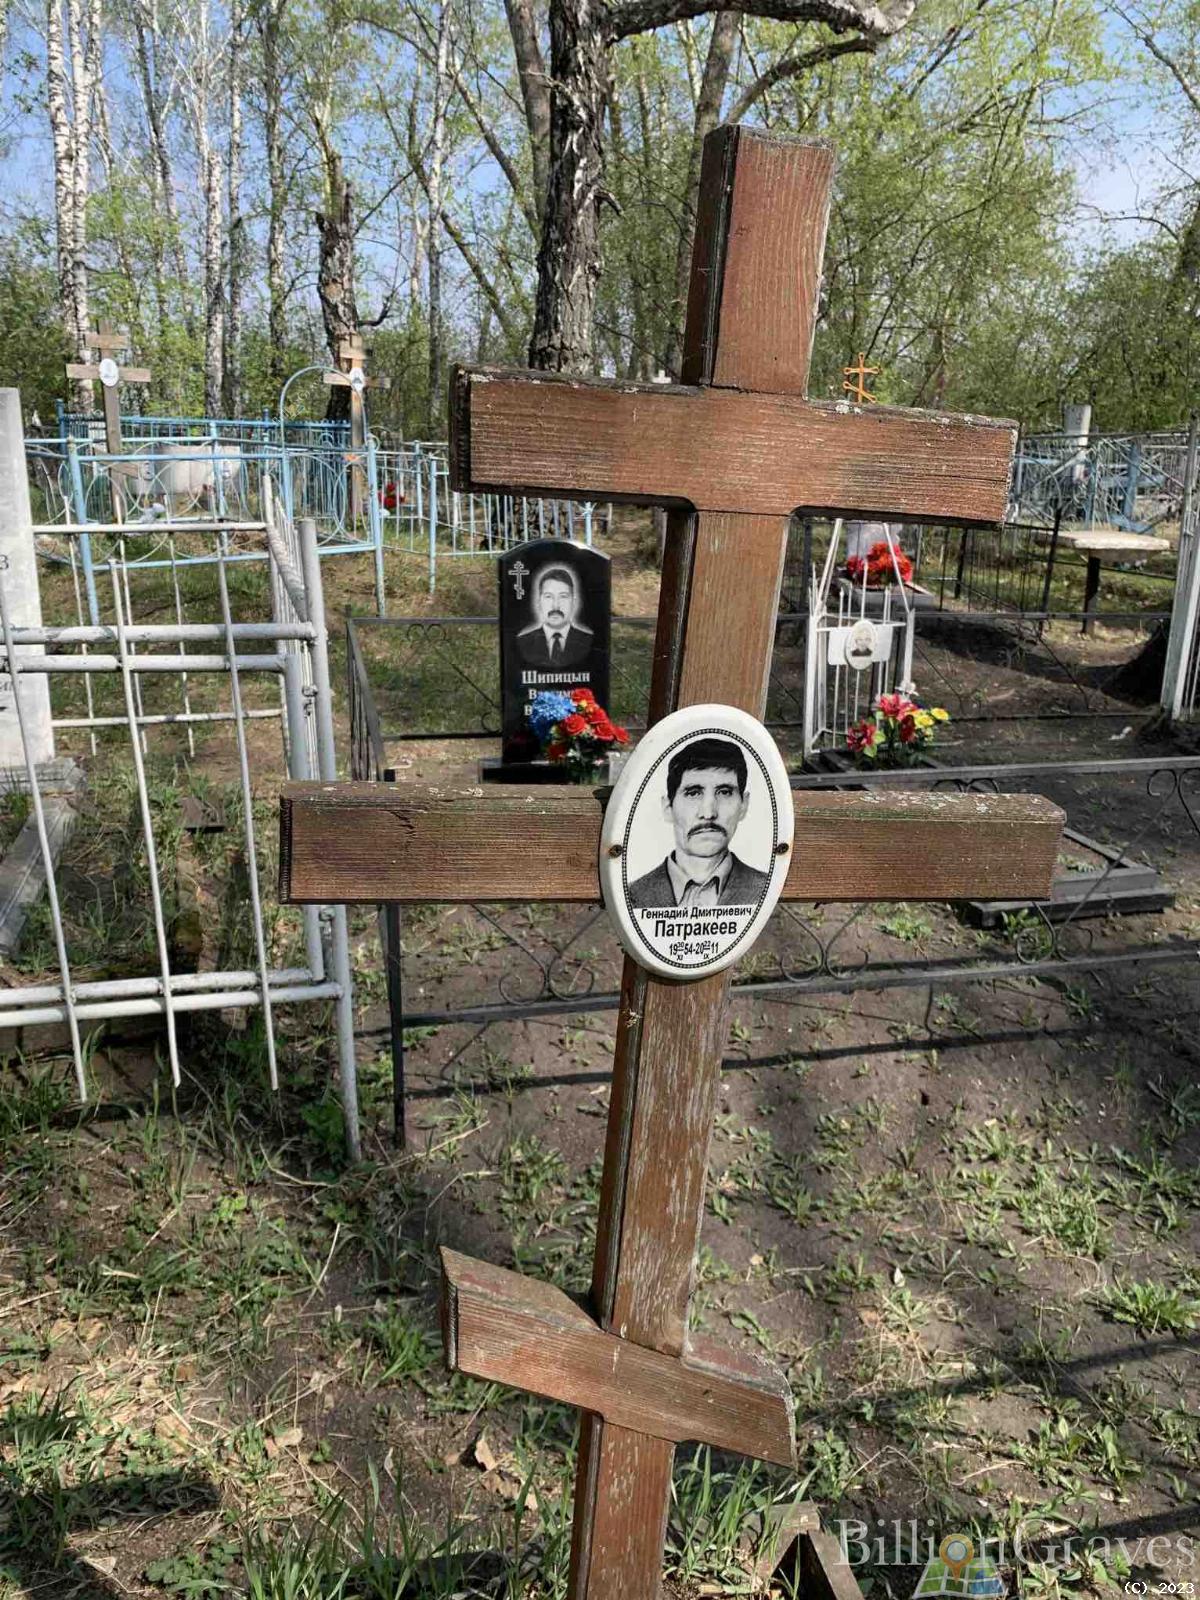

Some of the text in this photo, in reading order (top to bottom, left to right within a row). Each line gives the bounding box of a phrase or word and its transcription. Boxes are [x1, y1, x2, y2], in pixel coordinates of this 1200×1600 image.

[522, 670, 590, 684] Шипицын
[641, 907, 752, 919] Геннадий Дмитриевич
[655, 920, 737, 940] Патракеев
